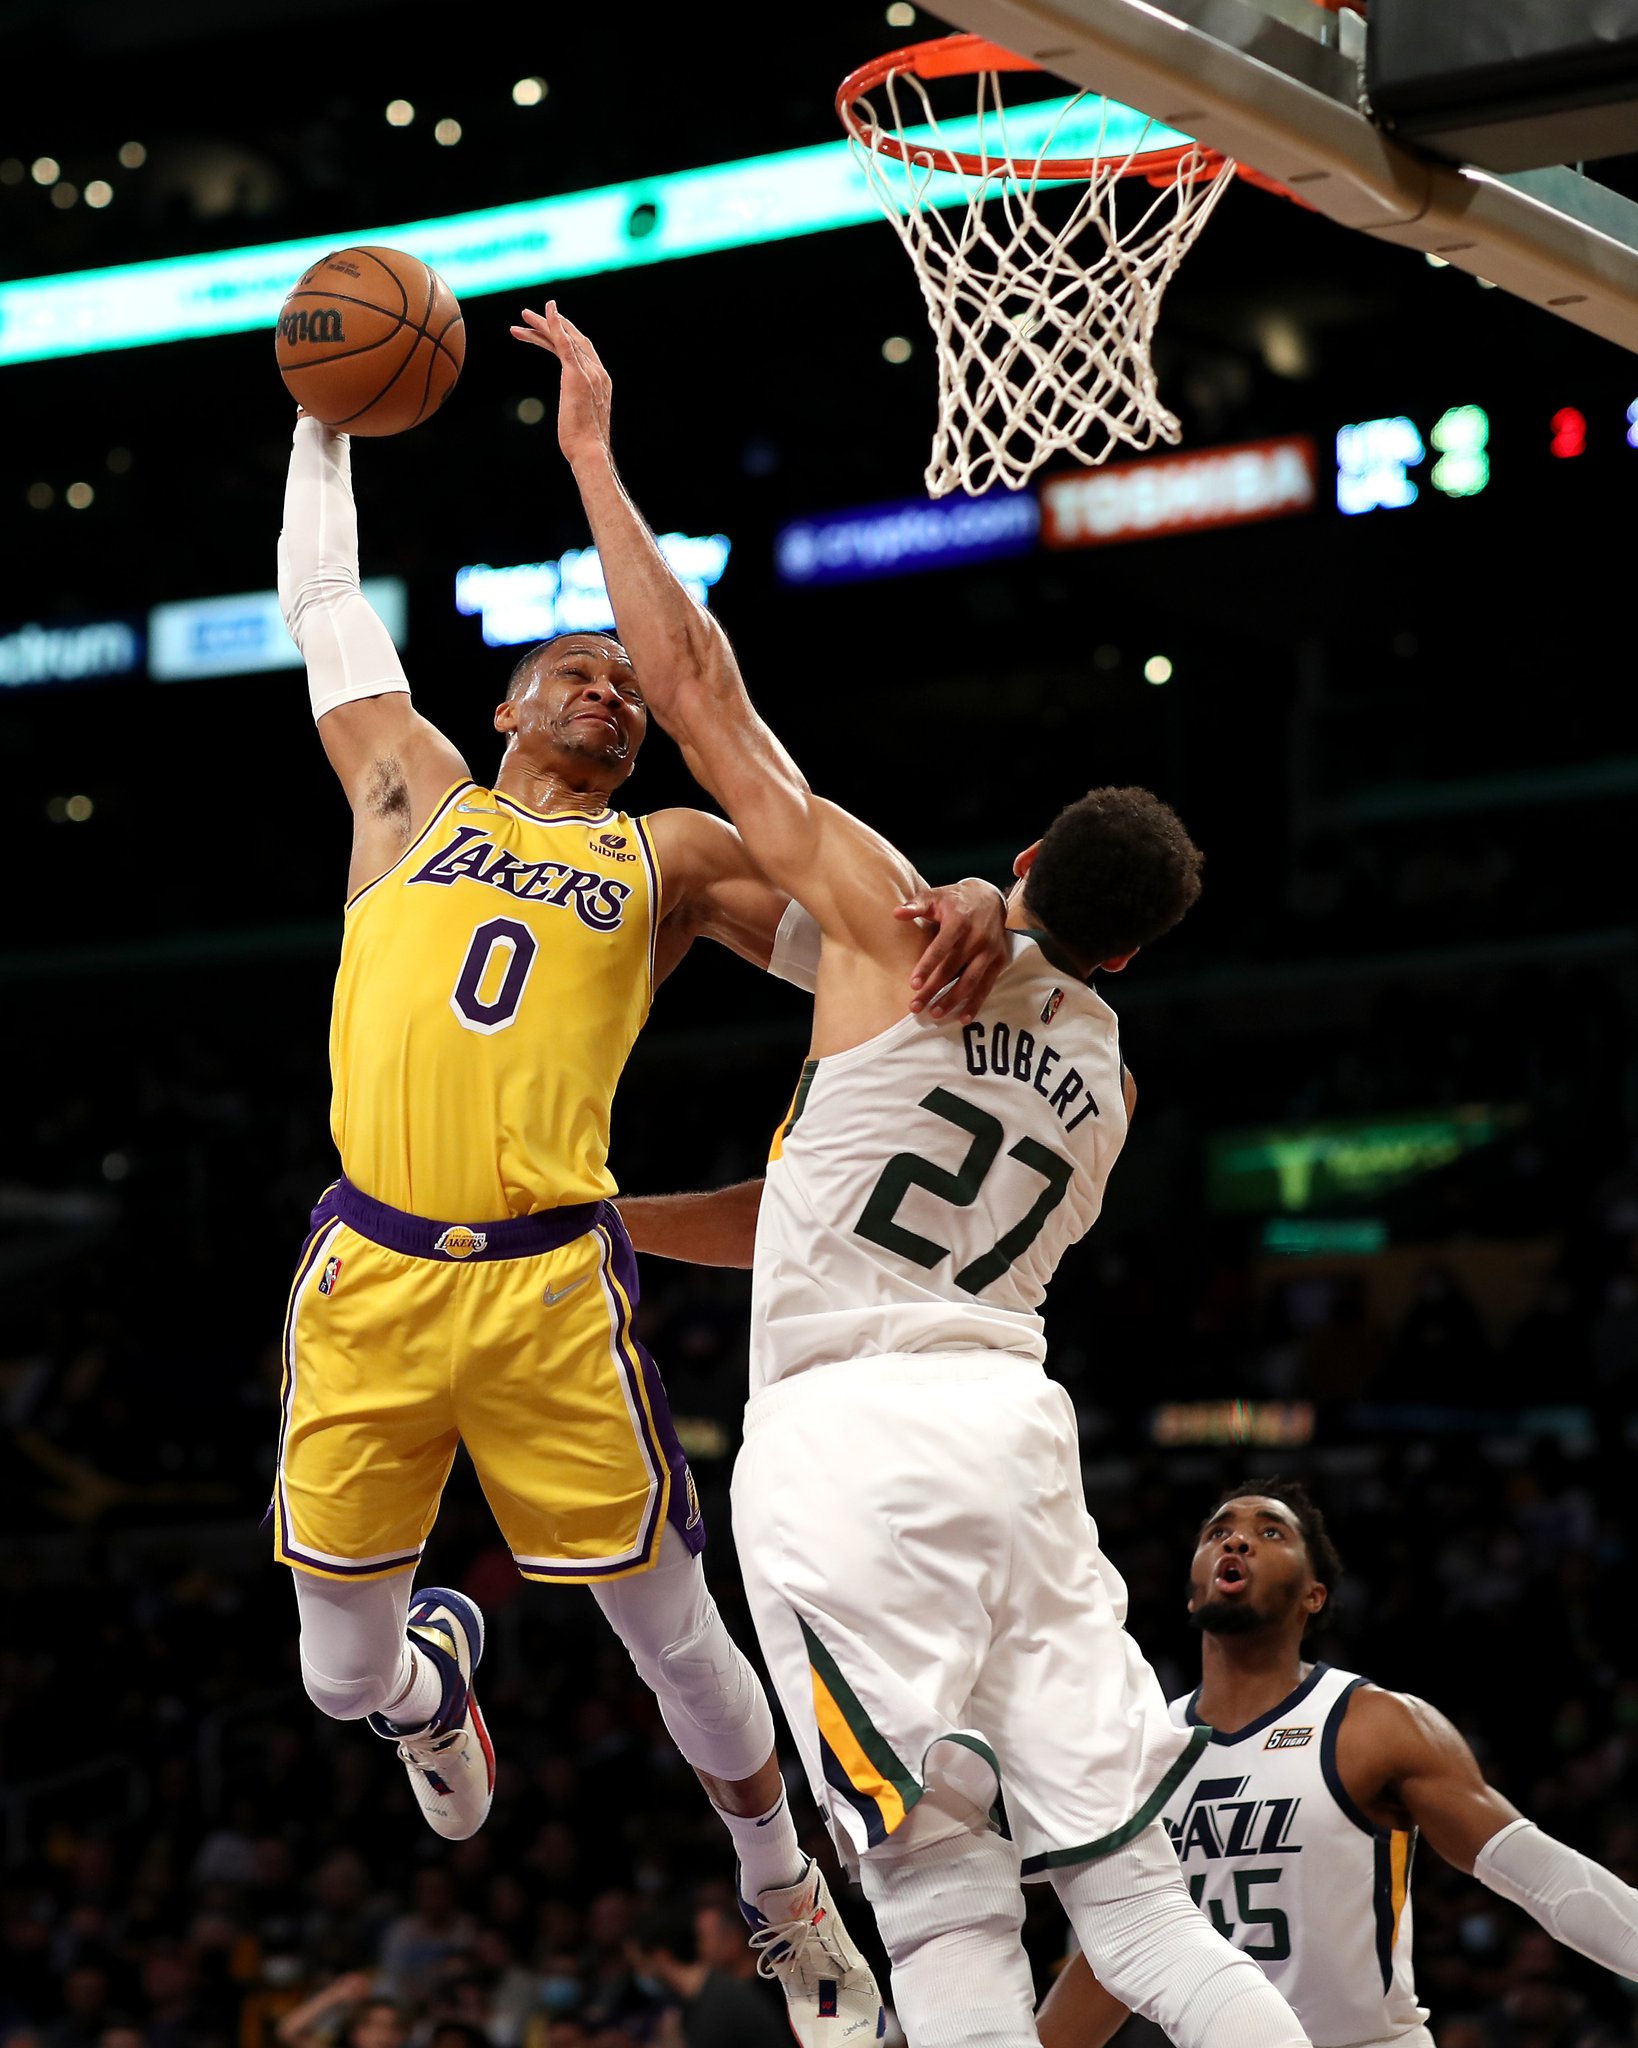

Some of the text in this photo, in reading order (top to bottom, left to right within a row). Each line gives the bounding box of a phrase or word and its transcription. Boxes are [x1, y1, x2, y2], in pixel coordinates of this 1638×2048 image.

[817, 495, 1038, 568] crypto.com
[1047, 446, 1314, 541] TOSHIBA
[404, 824, 635, 934] LAKERS
[589, 842, 637, 863] bibigo
[449, 915, 541, 1036] 0
[962, 1021, 1100, 1134] GOBERT
[853, 1086, 1075, 1296] 27
[435, 1233, 487, 1251] LAKERS
[1268, 1730, 1284, 1748] 5
[1280, 1737, 1310, 1747] FIGHT
[1162, 1774, 1303, 1863] JAZZ
